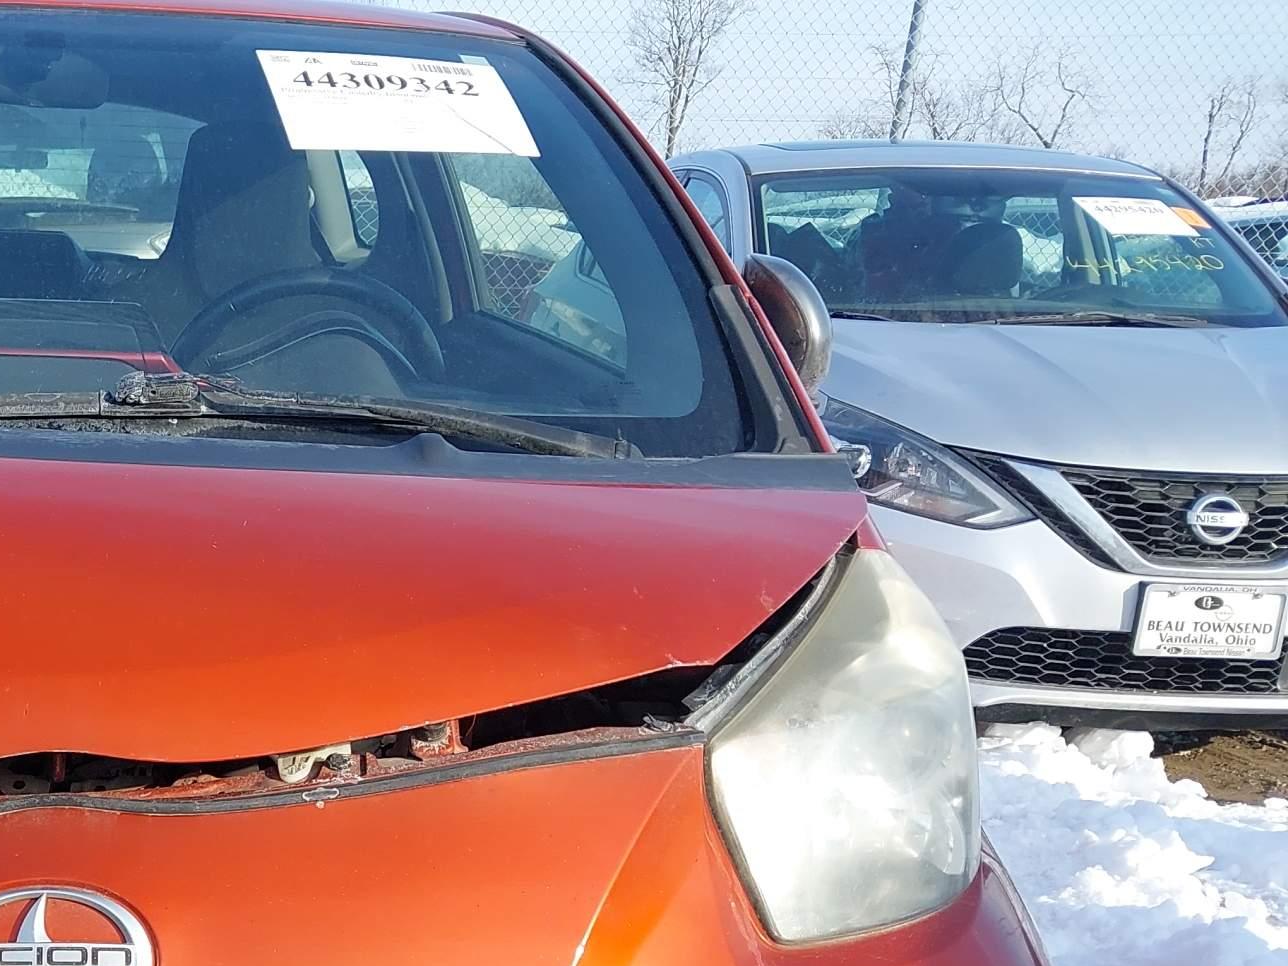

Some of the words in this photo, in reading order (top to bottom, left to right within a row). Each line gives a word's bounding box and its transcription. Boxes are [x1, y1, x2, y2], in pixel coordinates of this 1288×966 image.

[292, 70, 480, 97] 44309342
[1195, 513, 1244, 525] NISS
[1147, 620, 1185, 632] BEAU
[1192, 621, 1273, 635] TOWNSEND
[1159, 632, 1219, 646] Vandalia,
[1225, 634, 1256, 646] Ohio
